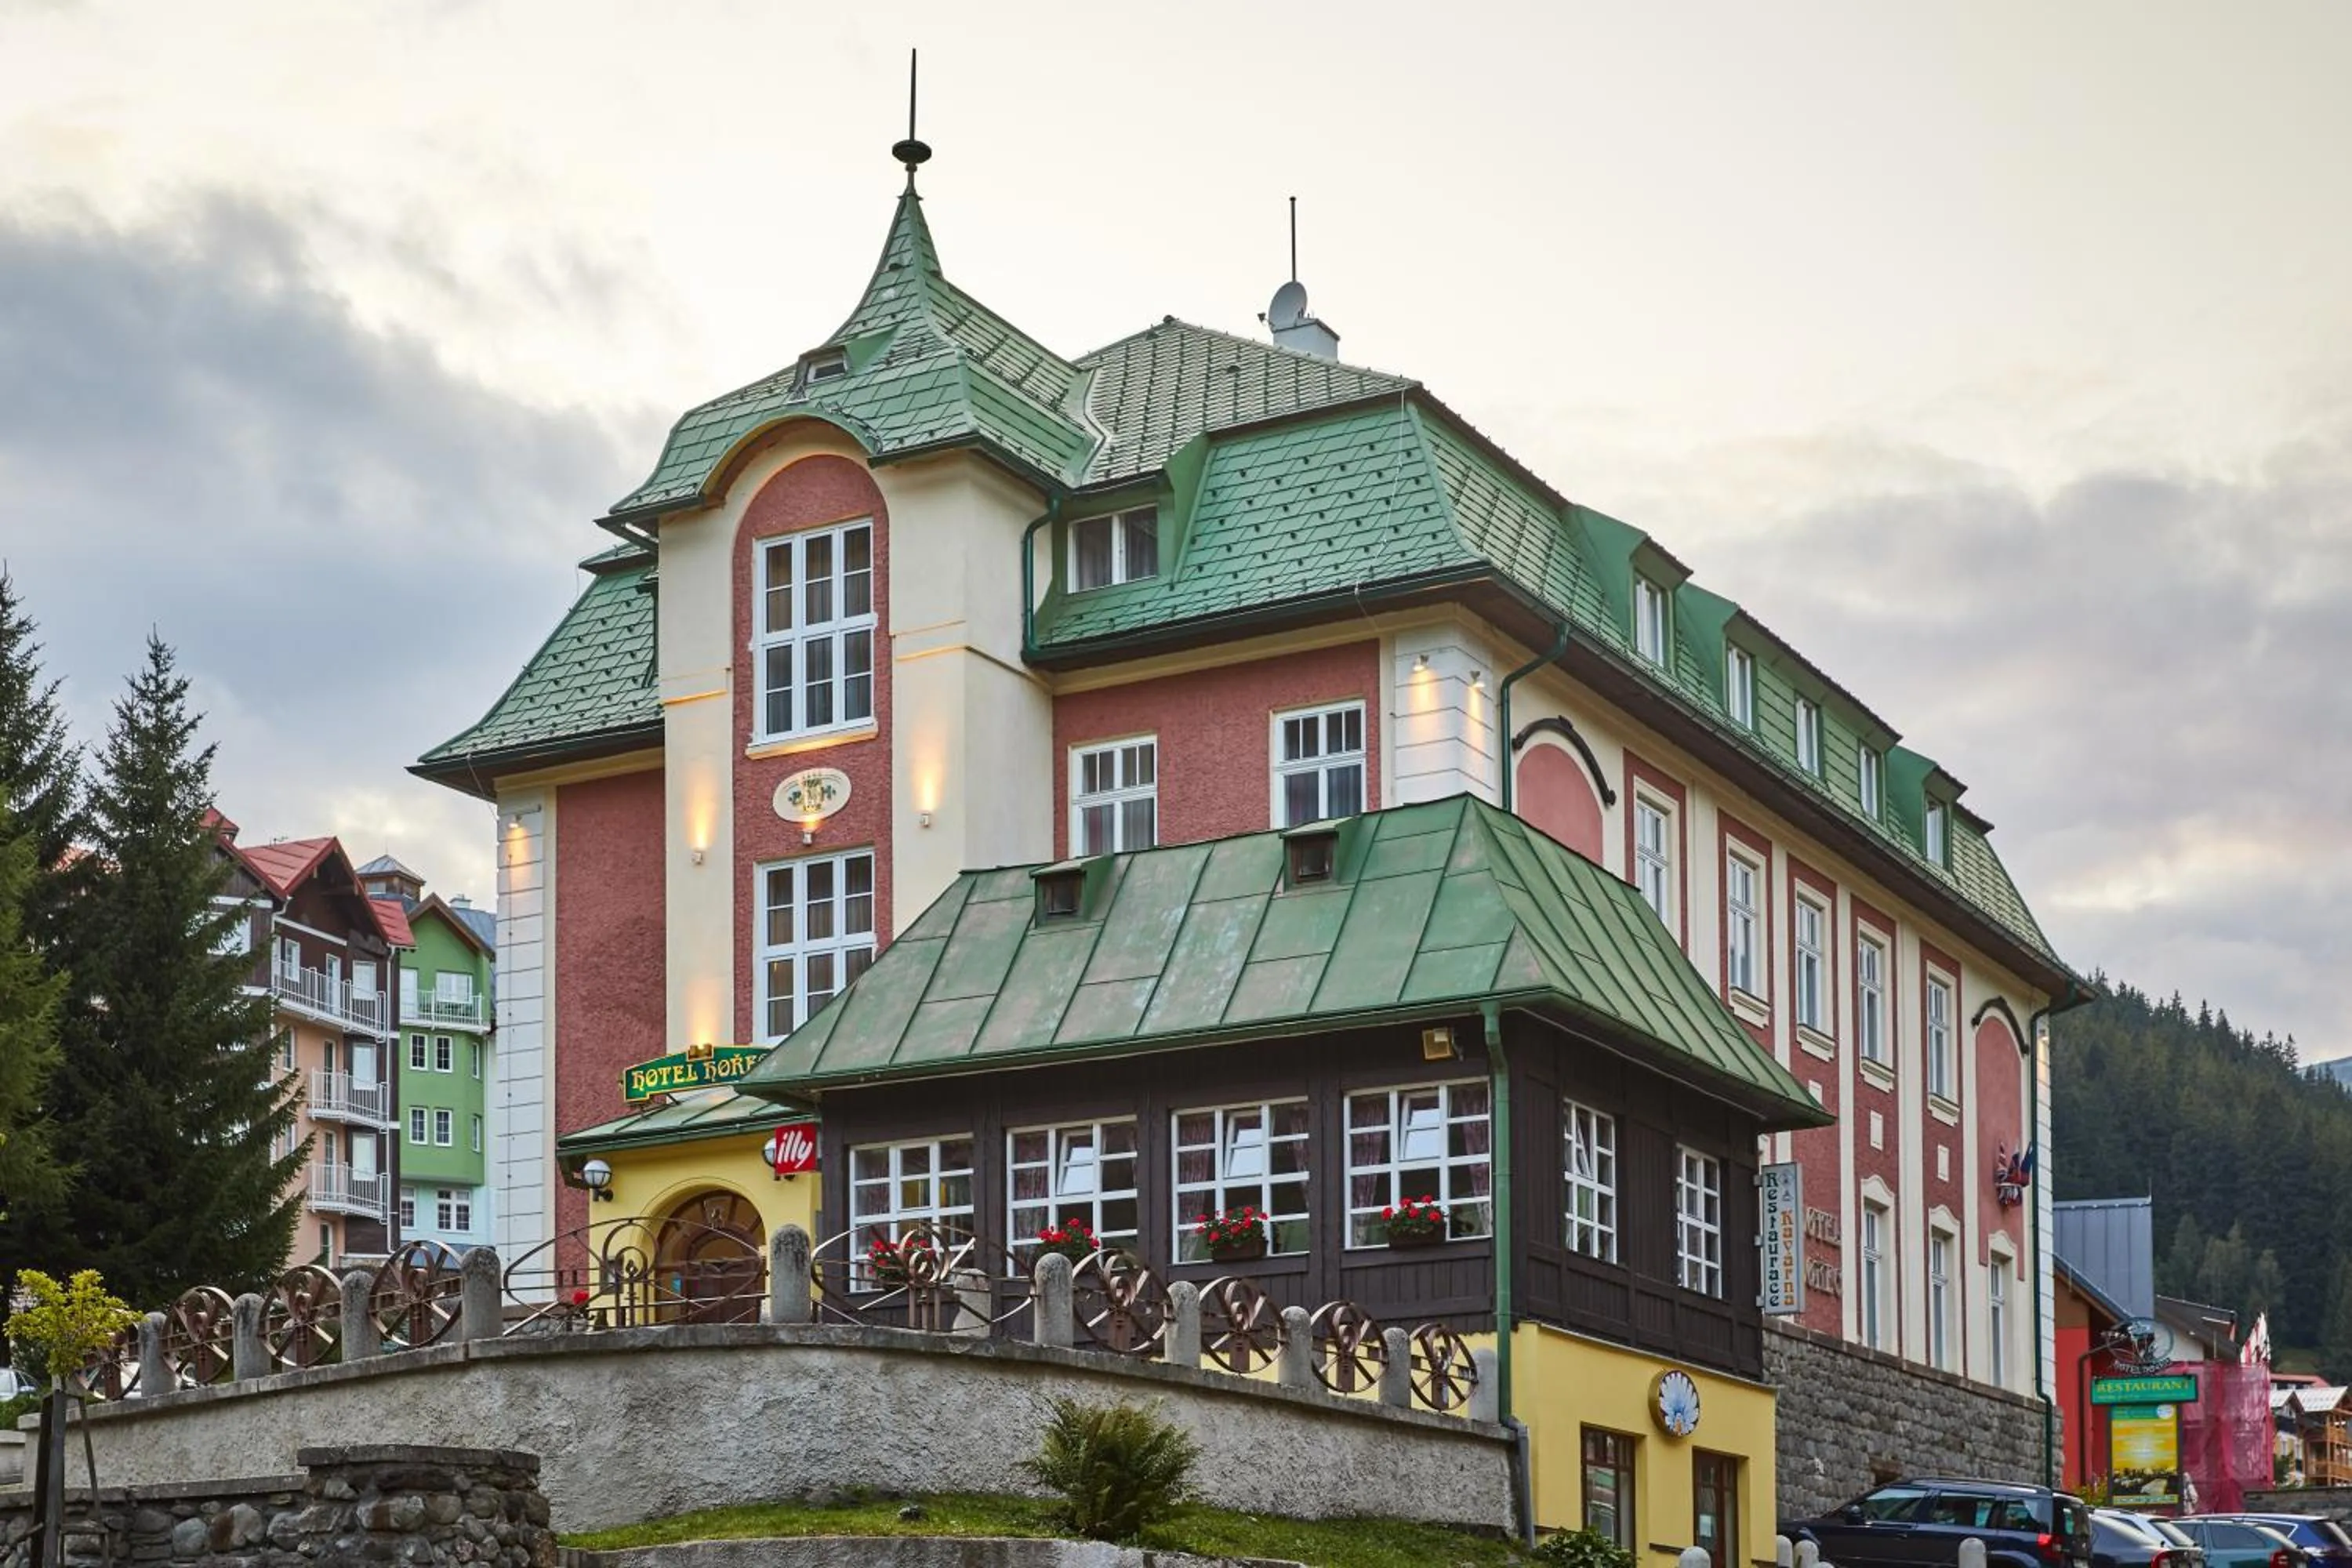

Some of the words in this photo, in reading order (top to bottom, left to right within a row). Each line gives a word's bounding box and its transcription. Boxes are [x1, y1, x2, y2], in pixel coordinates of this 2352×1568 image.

[632, 1064, 699, 1091] HOTEL
[777, 1130, 813, 1169] illy
[1766, 1172, 1780, 1307] Restaurace
[2096, 1380, 2189, 1393] RESTAURANT
